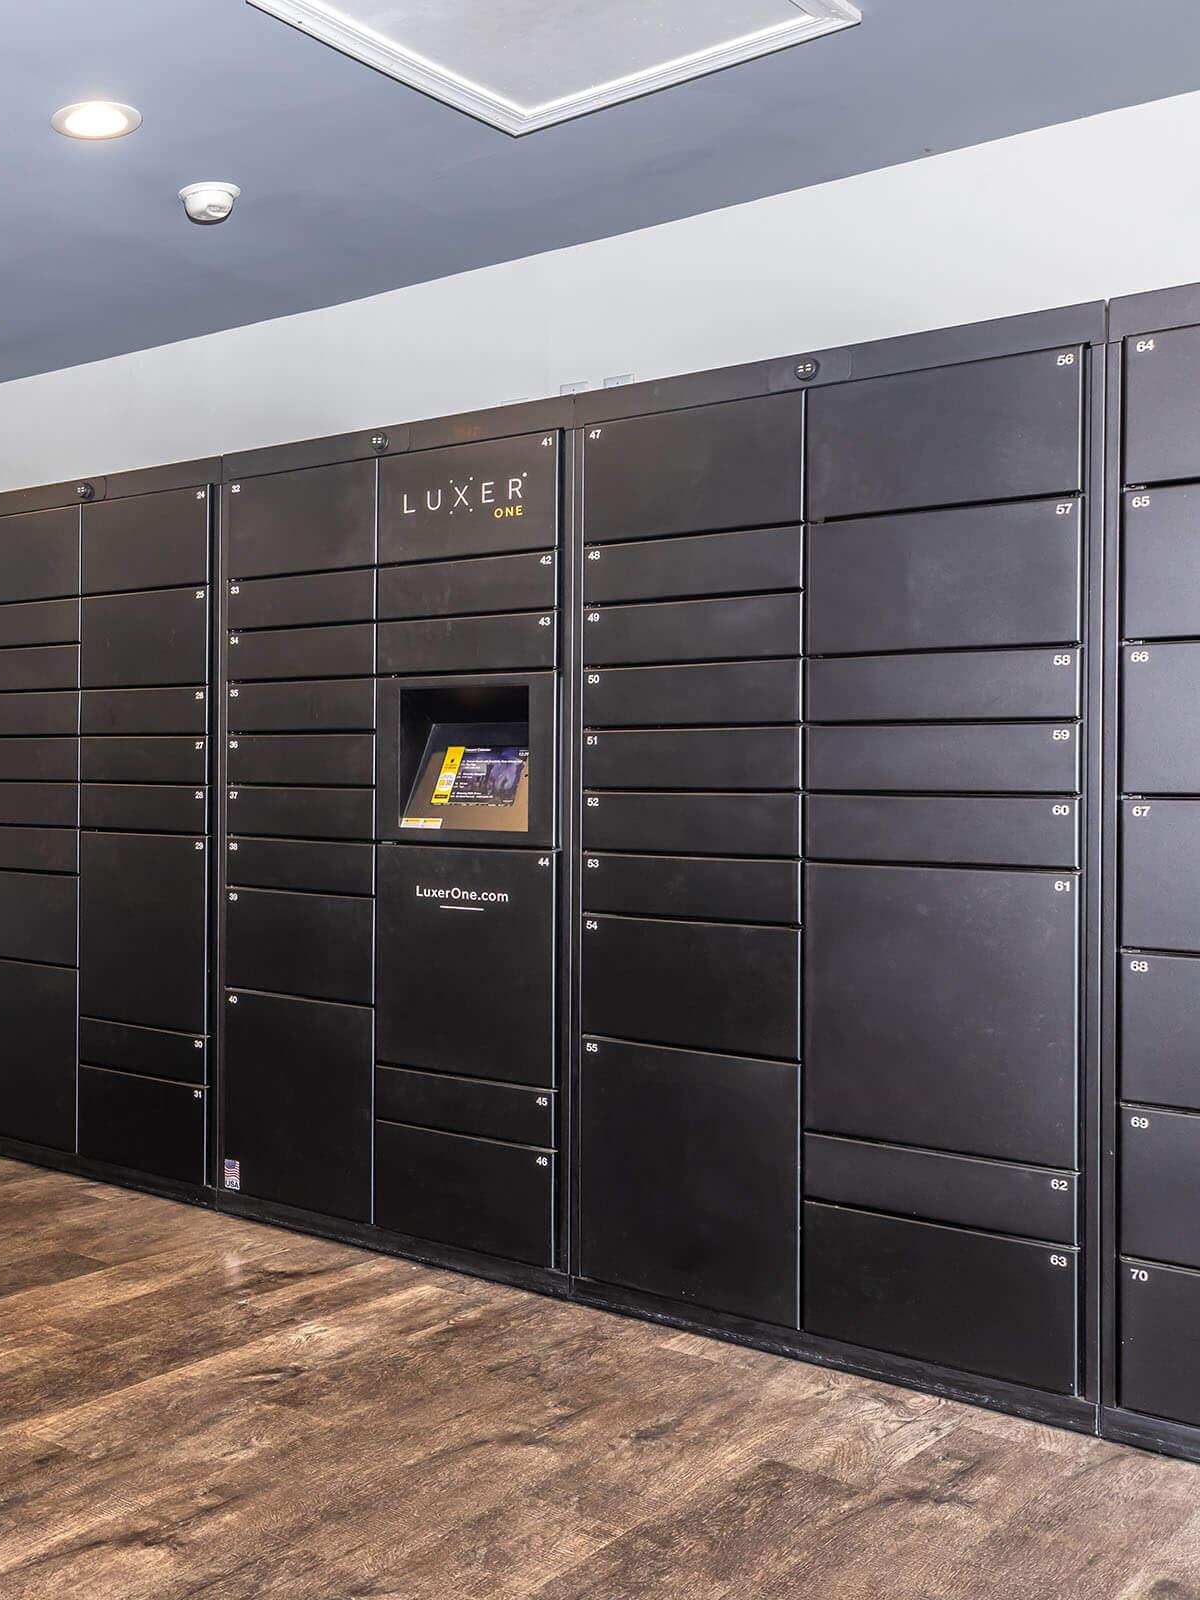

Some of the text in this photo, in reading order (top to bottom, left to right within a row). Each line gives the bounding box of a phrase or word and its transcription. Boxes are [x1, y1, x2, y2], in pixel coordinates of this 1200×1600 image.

[1136, 339, 1155, 353] 64
[1056, 353, 1075, 366] 56
[588, 428, 602, 440] 47
[541, 436, 553, 447] 41
[231, 484, 241, 494] 32
[402, 476, 524, 515] LUXER
[1131, 495, 1151, 508] 65
[493, 504, 524, 519] ONE
[1055, 502, 1073, 515] 57
[539, 555, 553, 565] 42
[587, 550, 601, 561] 48
[230, 585, 240, 595] 33
[538, 616, 551, 627] 43
[587, 612, 600, 623] 49
[229, 636, 239, 645] 34
[1052, 654, 1071, 666] 58
[1130, 650, 1150, 663] 66
[587, 674, 600, 685] 50
[229, 688, 239, 697] 35
[586, 735, 598, 746] 51
[1052, 729, 1070, 741] 59
[229, 740, 239, 749] 36
[229, 791, 239, 800] 37
[586, 797, 600, 807] 52
[1051, 804, 1070, 816] 60
[1131, 805, 1151, 817] 67
[228, 842, 238, 851] 38
[537, 857, 550, 867] 44
[587, 858, 600, 869] 53
[1054, 880, 1071, 892] 61
[228, 892, 238, 901] 39
[415, 884, 509, 903] LuxerOne.com
[585, 920, 598, 931] 54
[1129, 960, 1149, 973] 68
[228, 995, 238, 1004] 40
[585, 1042, 599, 1053] 55
[535, 1096, 548, 1107] 45
[1130, 1116, 1150, 1129] 69
[535, 1156, 548, 1167] 46
[225, 1179, 240, 1189] USA
[1050, 1178, 1069, 1192] 62
[1049, 1254, 1068, 1268] 63
[1129, 1268, 1149, 1282] 70
